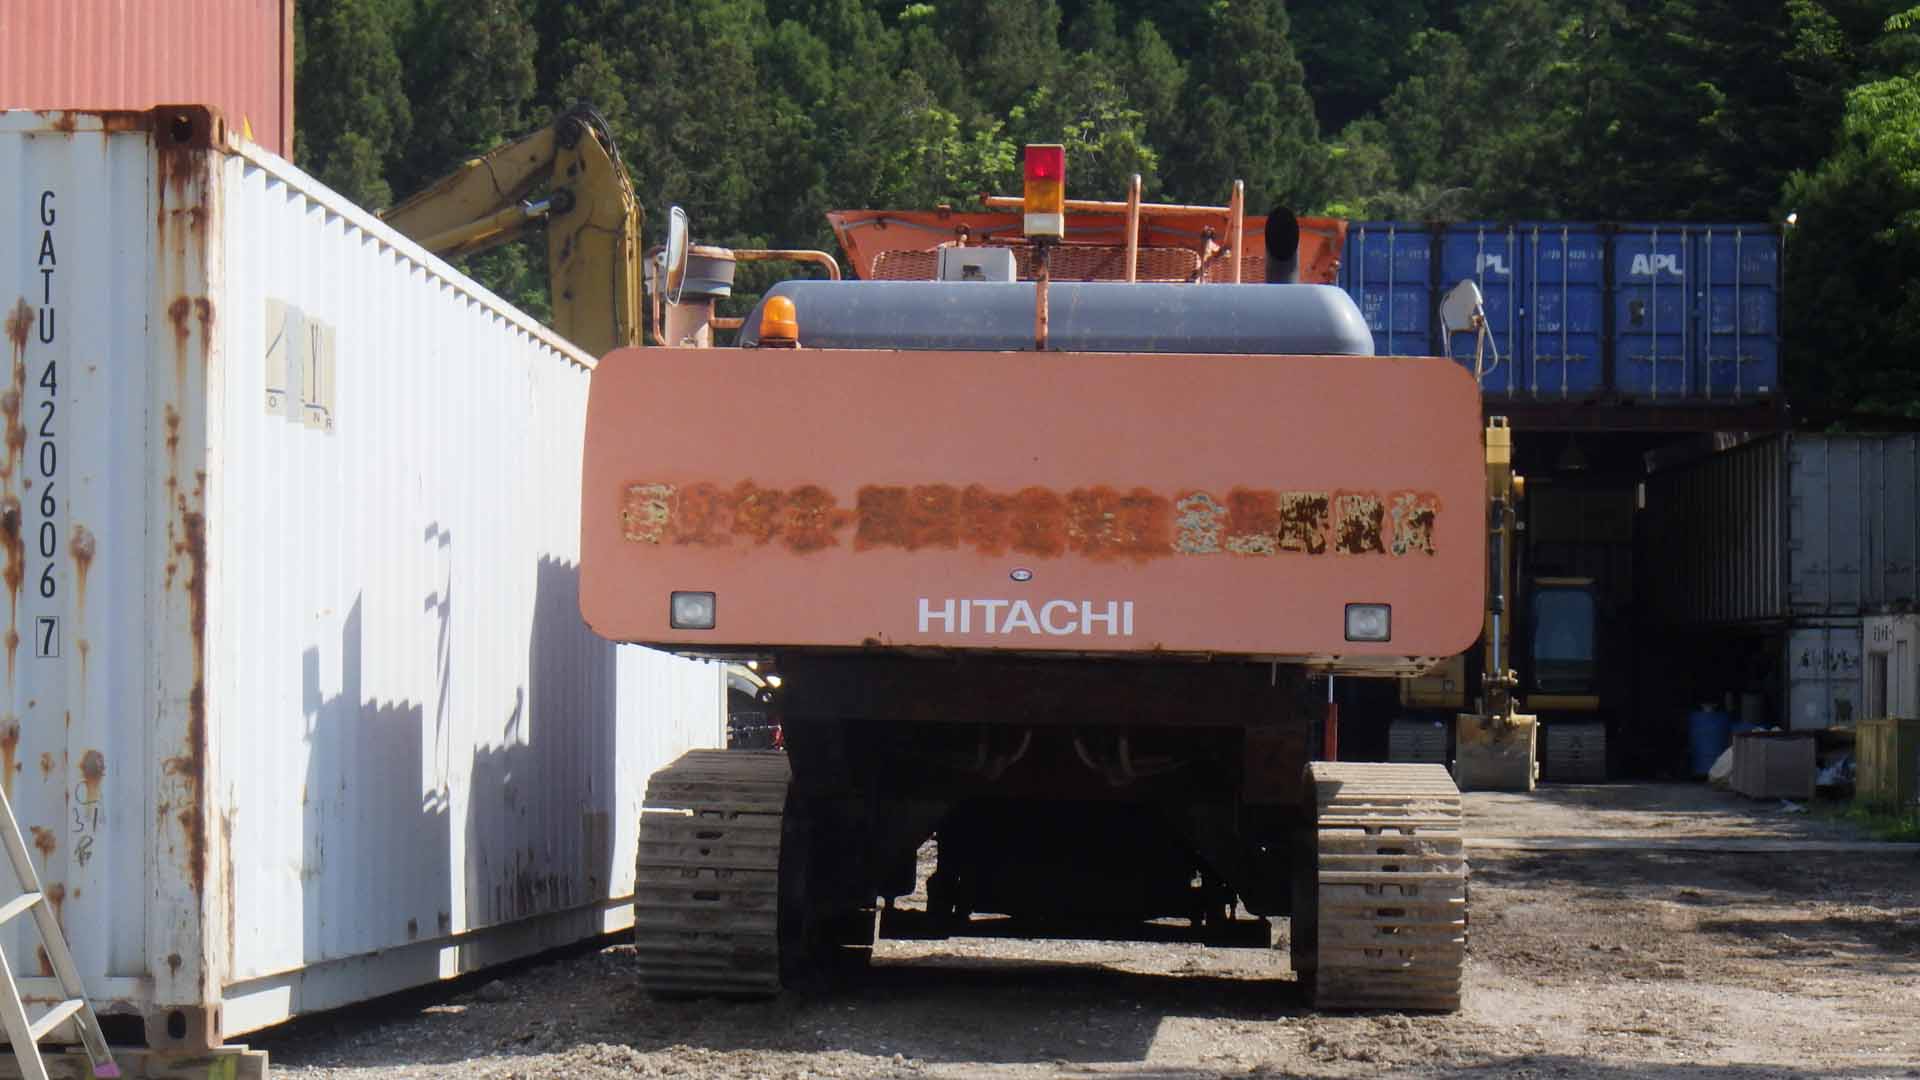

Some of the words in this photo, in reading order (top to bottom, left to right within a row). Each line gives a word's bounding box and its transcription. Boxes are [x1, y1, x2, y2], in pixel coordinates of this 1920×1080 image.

[38, 190, 57, 344] GATU
[1631, 253, 1684, 276] APL
[39, 361, 57, 598] 420606
[918, 598, 1134, 636] HITACHI
[39, 619, 56, 655] 7
